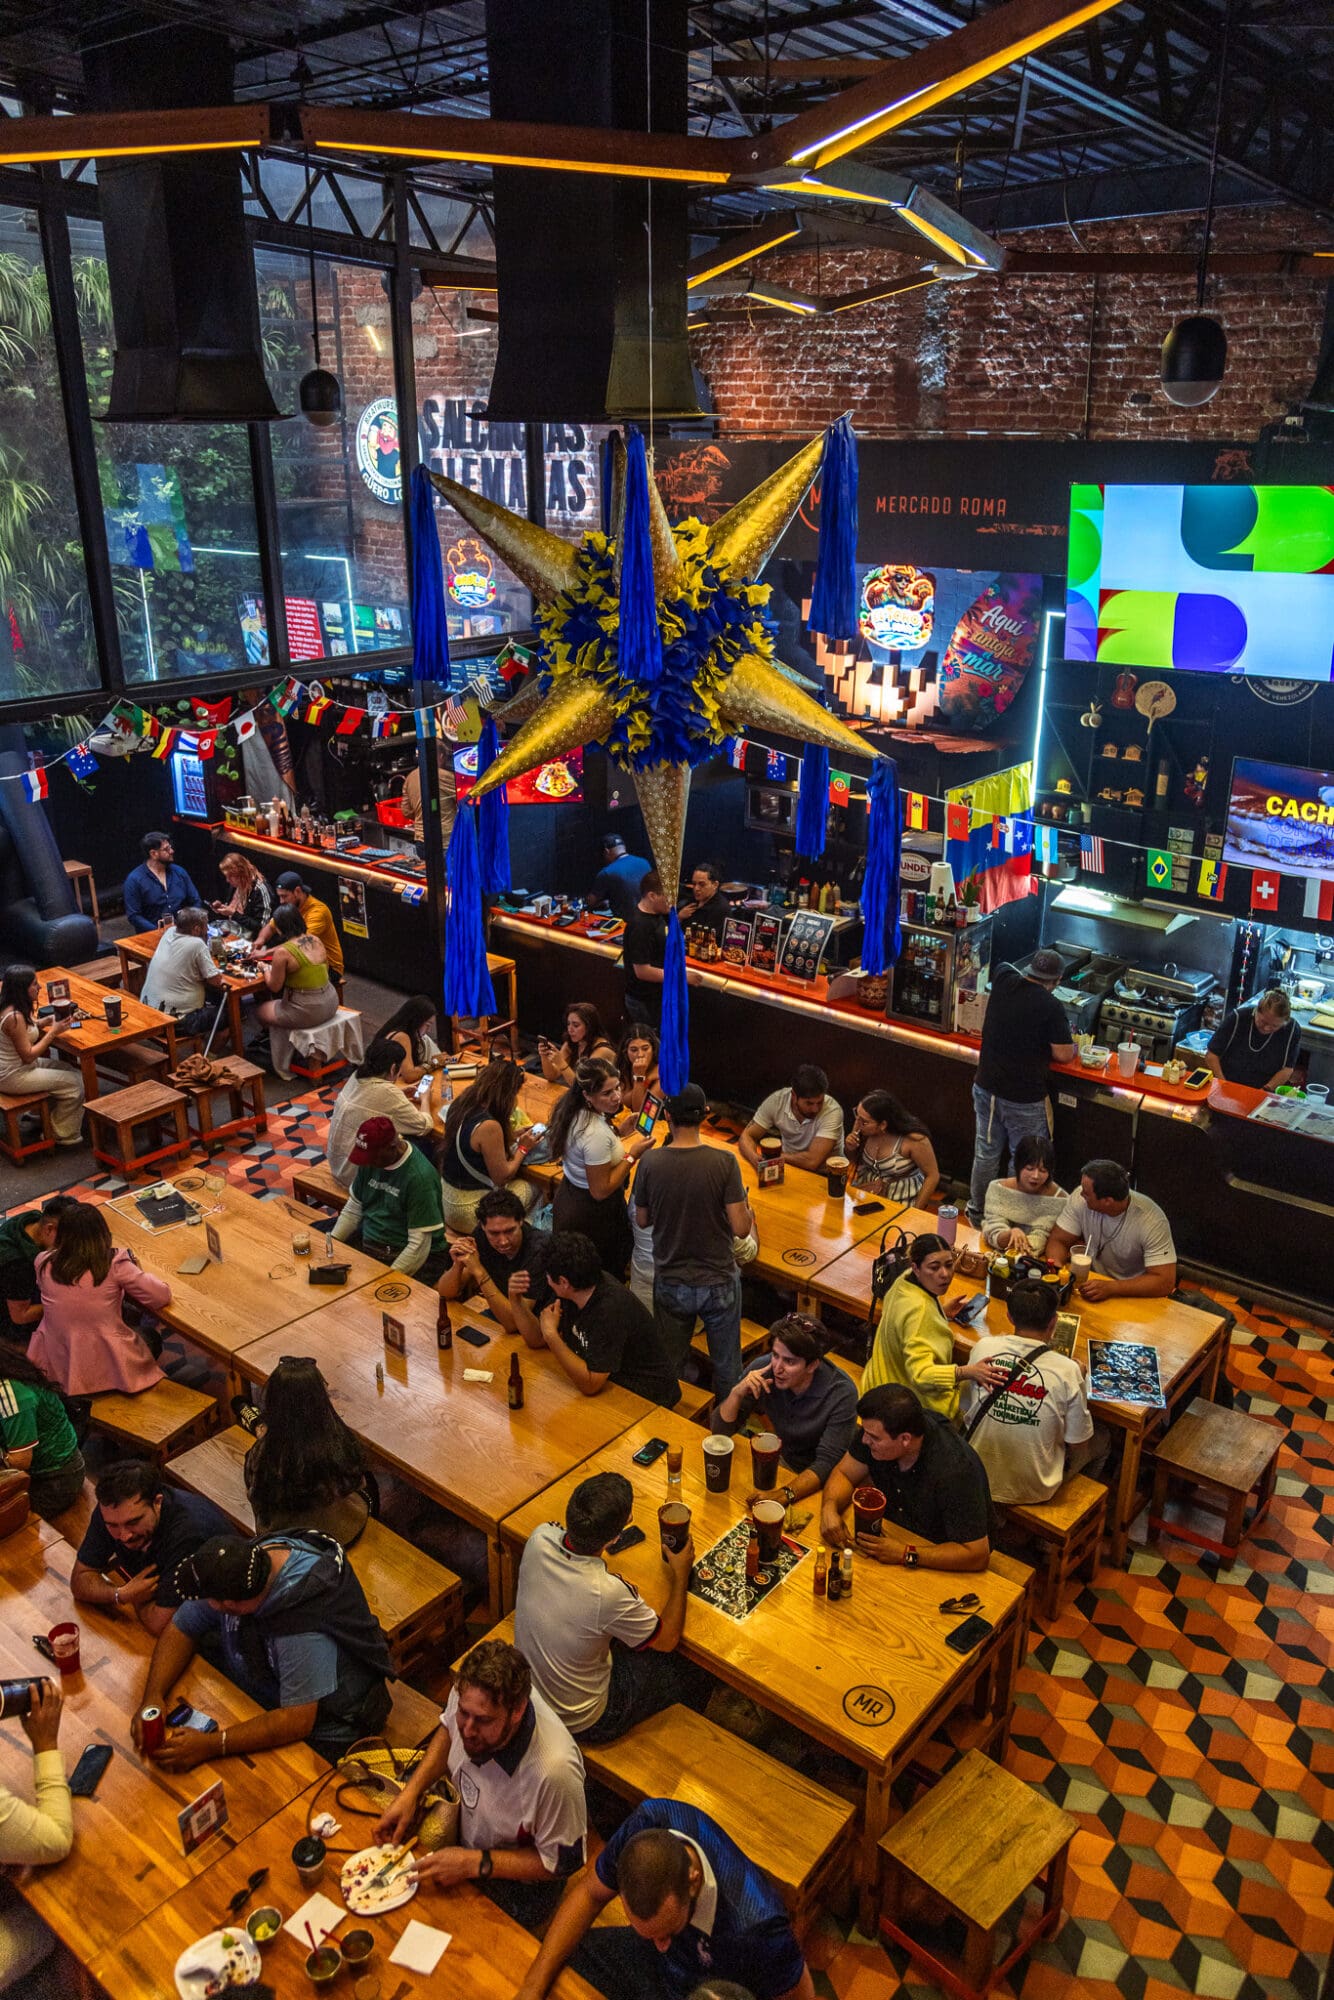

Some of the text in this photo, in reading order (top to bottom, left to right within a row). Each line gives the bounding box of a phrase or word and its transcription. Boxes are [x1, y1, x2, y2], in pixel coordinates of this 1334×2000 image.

[876, 496, 1007, 517] MERCADO ROMA
[980, 605, 1027, 636] Aquí
[972, 633, 1016, 658] antoja
[962, 651, 1003, 681] mar
[1266, 795, 1334, 826] CACH
[901, 861, 932, 874] UNDET
[992, 1408, 1041, 1427] TOURNAMENT
[852, 1693, 884, 1718] MR
